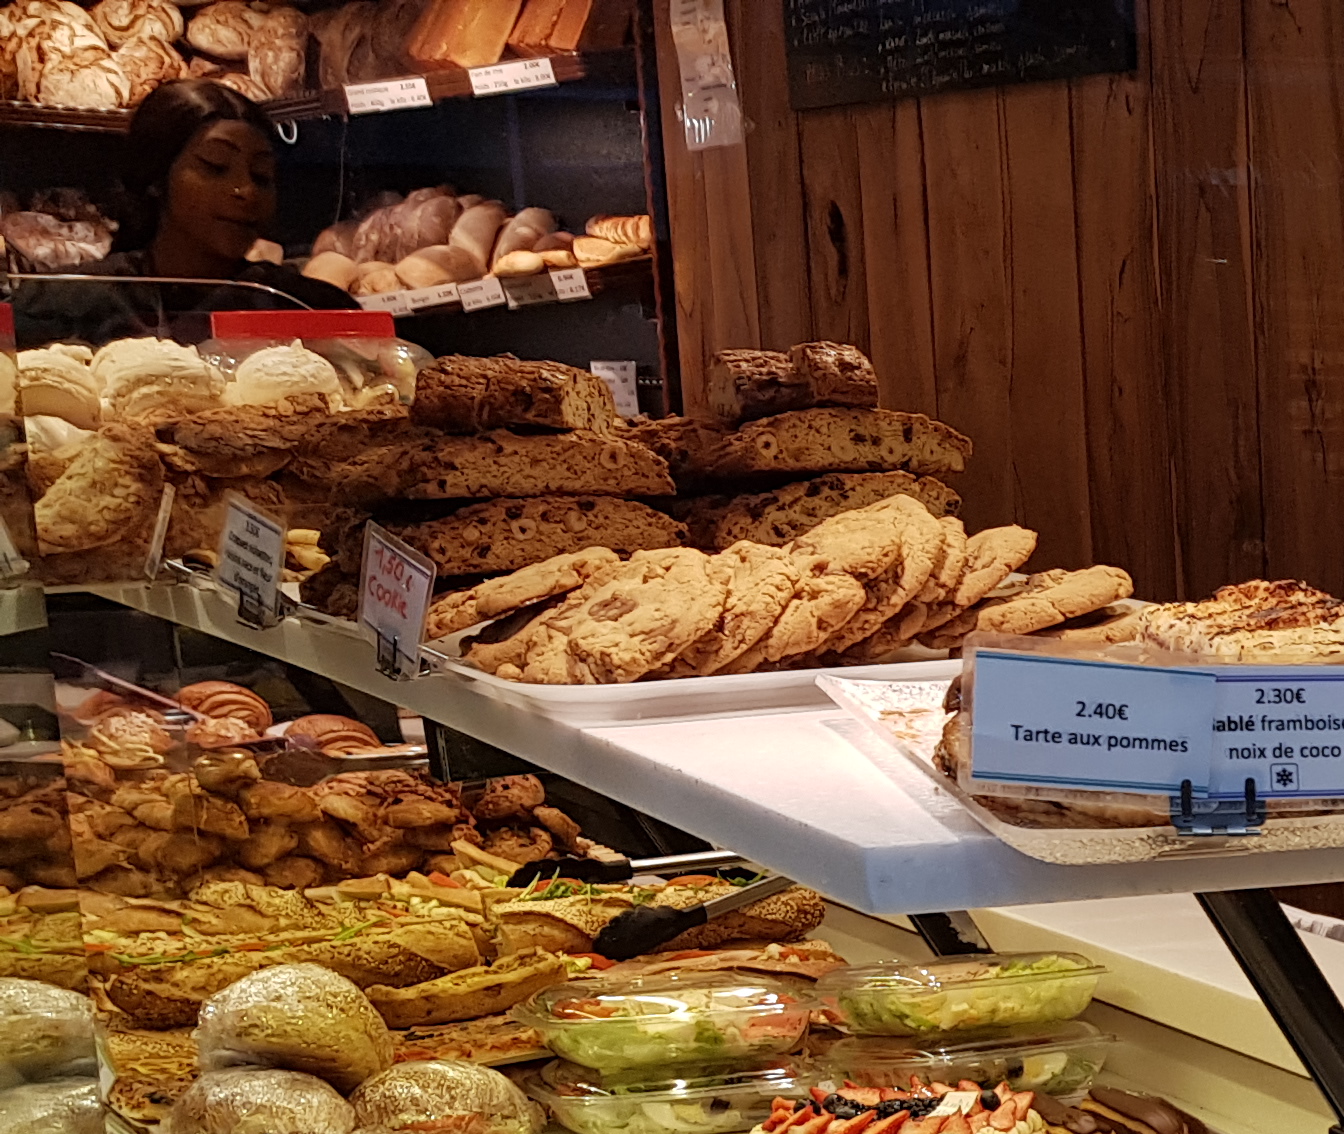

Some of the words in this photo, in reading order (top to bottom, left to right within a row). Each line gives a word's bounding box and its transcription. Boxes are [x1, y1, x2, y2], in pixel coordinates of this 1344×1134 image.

[1254, 687, 1306, 705] 2.30€
[1075, 701, 1129, 721] 2.40€
[1010, 724, 1063, 744] Tarte
[1068, 731, 1102, 748] aux
[1107, 734, 1188, 754] pommes
[1228, 742, 1268, 760] noix
[1272, 742, 1294, 759] de
[1299, 744, 1342, 759] coco
